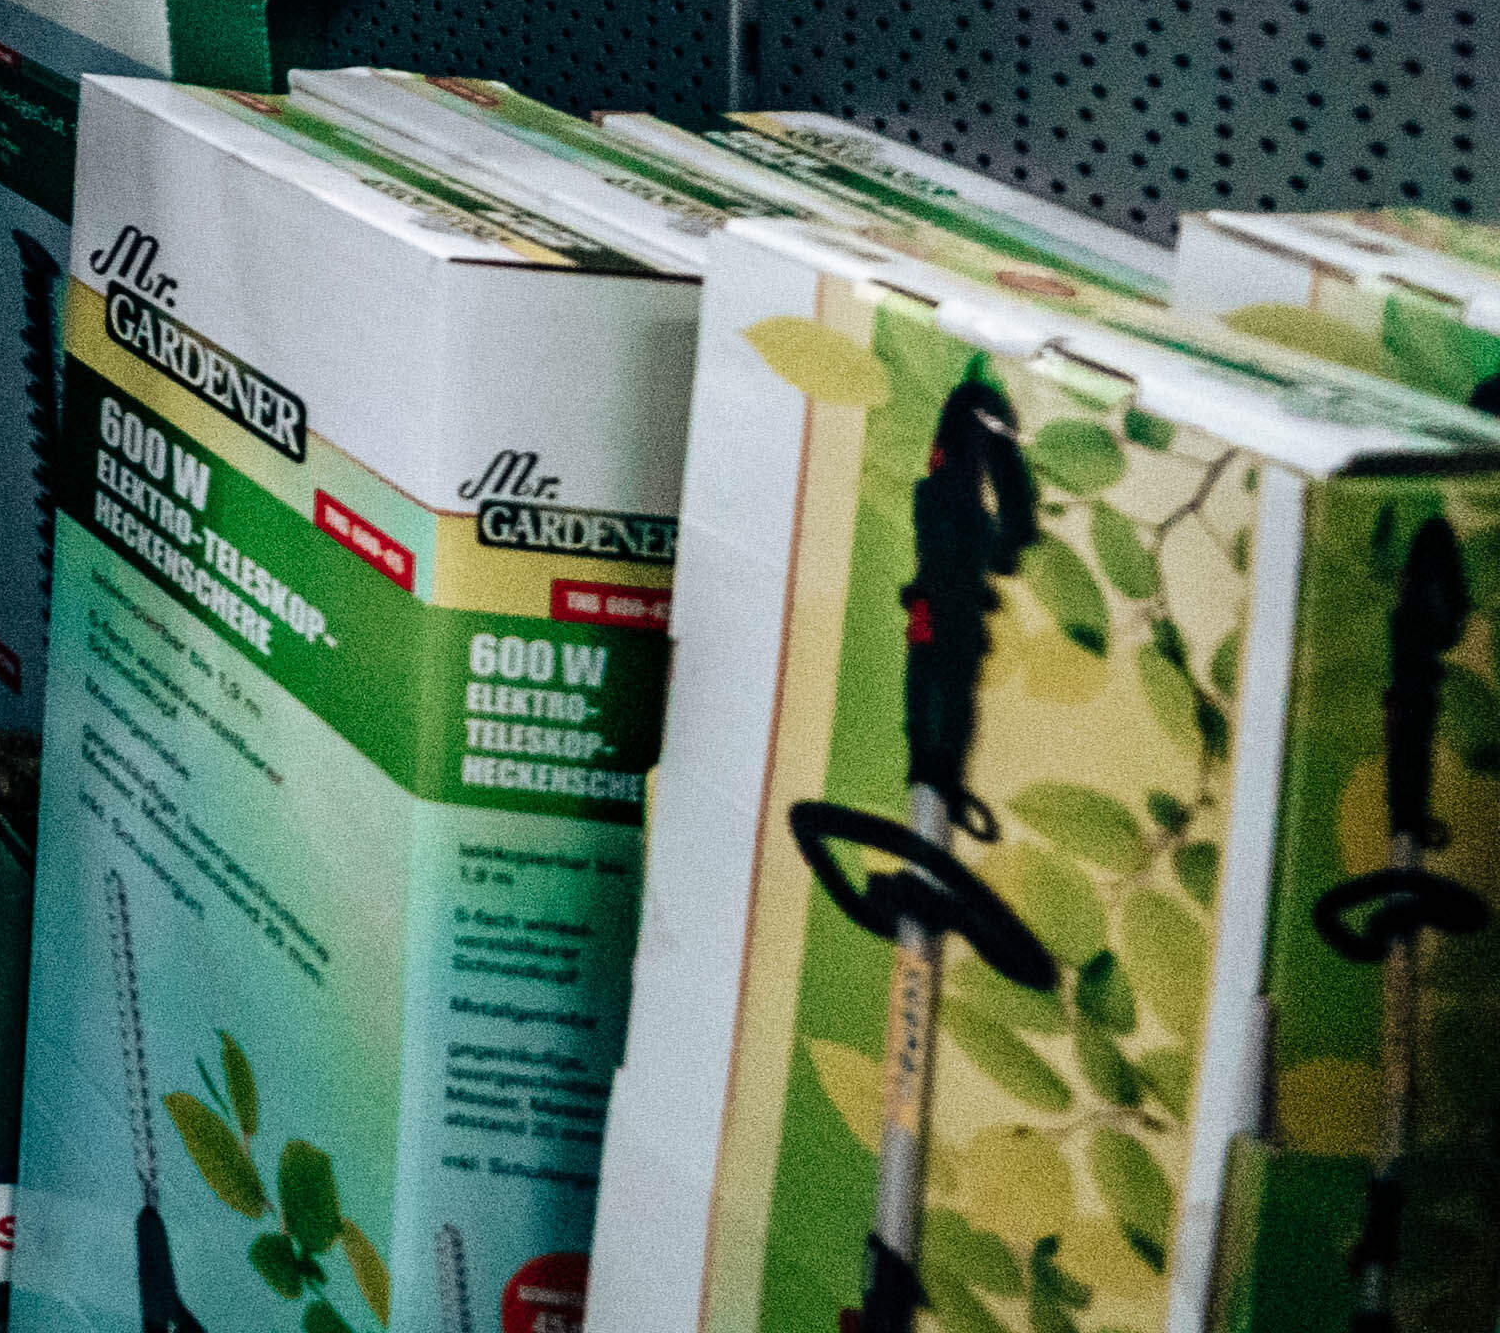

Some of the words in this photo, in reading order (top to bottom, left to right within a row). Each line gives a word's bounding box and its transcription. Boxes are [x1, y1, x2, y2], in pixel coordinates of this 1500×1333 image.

[90, 226, 177, 307] Mr.
[109, 292, 303, 457] GARDENER
[101, 396, 168, 482] 600
[172, 448, 211, 513] W
[460, 449, 561, 502] Mr.
[98, 448, 339, 649] ELEKTRO-TELESKOP-
[482, 503, 679, 561] GARDENER
[96, 497, 272, 657] HECKENSCHERE
[470, 636, 555, 681] 600
[563, 646, 608, 688] W
[466, 685, 598, 724] ELEKTRO-
[465, 720, 618, 760] TELESKOP-
